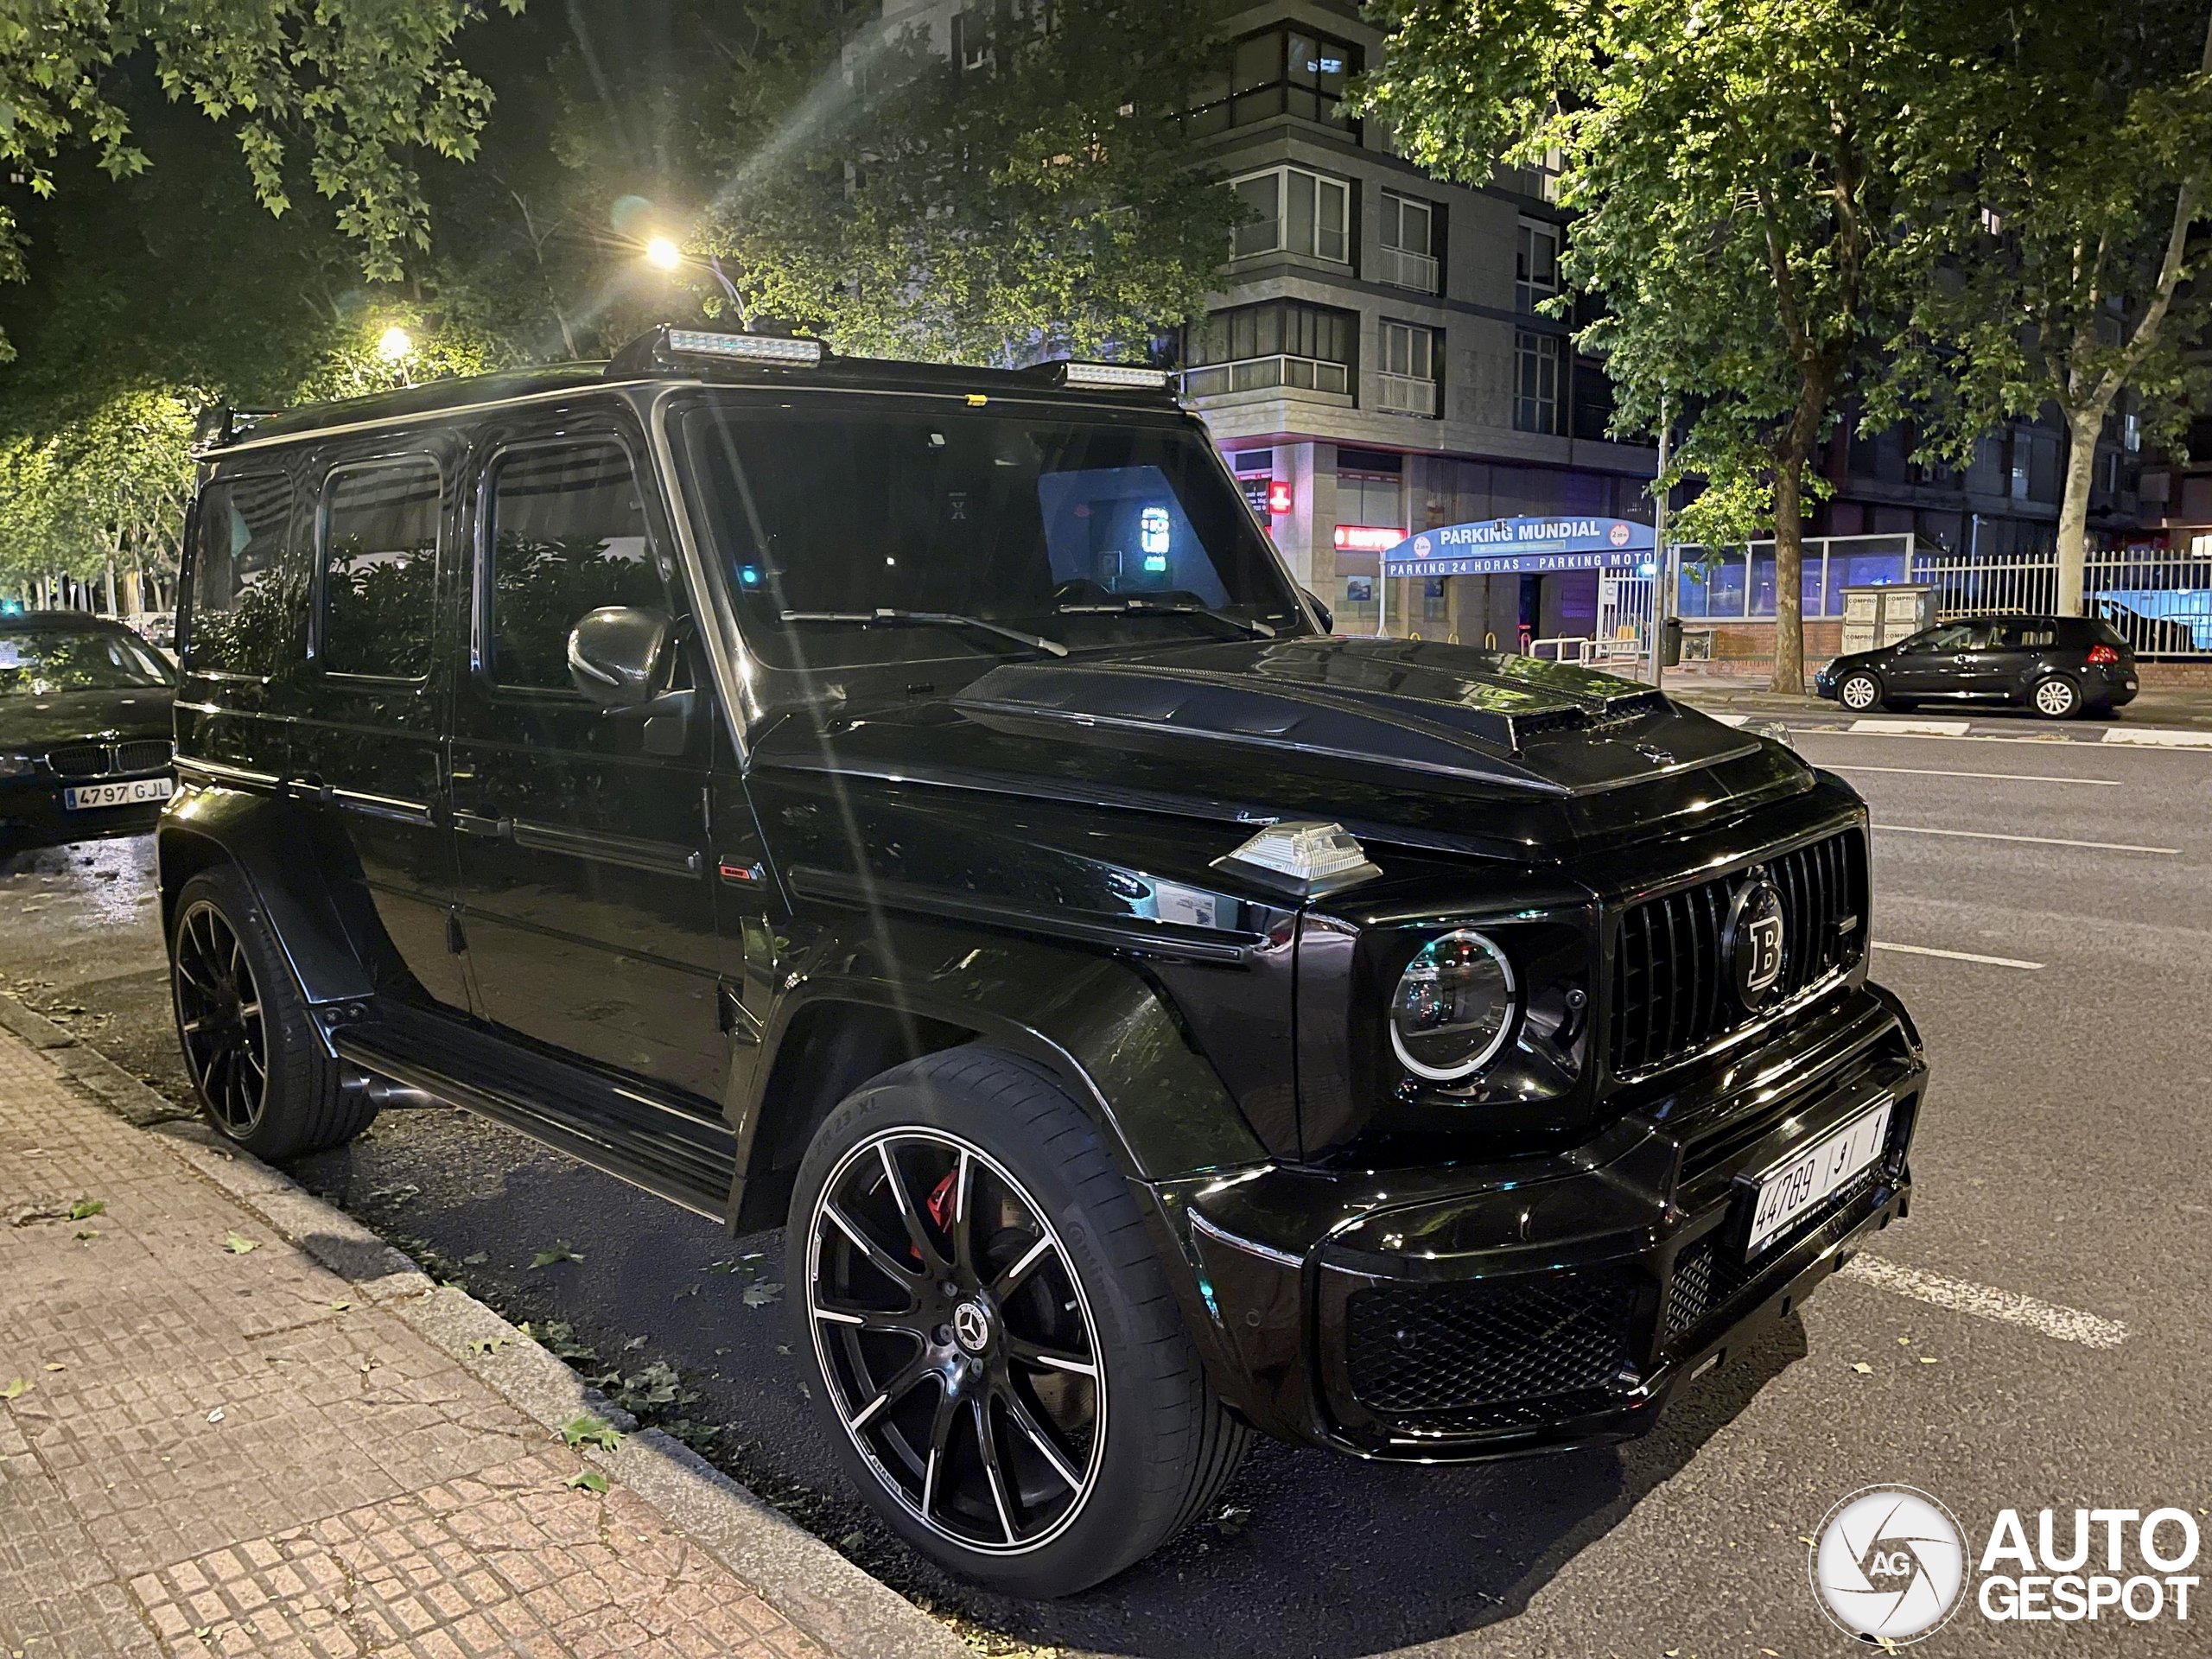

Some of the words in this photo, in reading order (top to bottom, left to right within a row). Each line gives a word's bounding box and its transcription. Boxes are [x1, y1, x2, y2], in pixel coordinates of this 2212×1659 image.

[1440, 526, 1513, 545] PARKING
[1518, 521, 1600, 540] MUNDIAL
[1390, 563, 1445, 575] PARKING
[1452, 562, 1467, 573] 24
[1474, 559, 1520, 571] HORAS
[1539, 555, 1601, 569] PARKING
[1611, 552, 1652, 565] MOTO
[80, 786, 127, 804] 4797
[135, 782, 169, 798] GJL
[1747, 916, 1783, 992] B
[1871, 1113, 1882, 1154] 1
[1757, 1159, 1815, 1231] 44789
